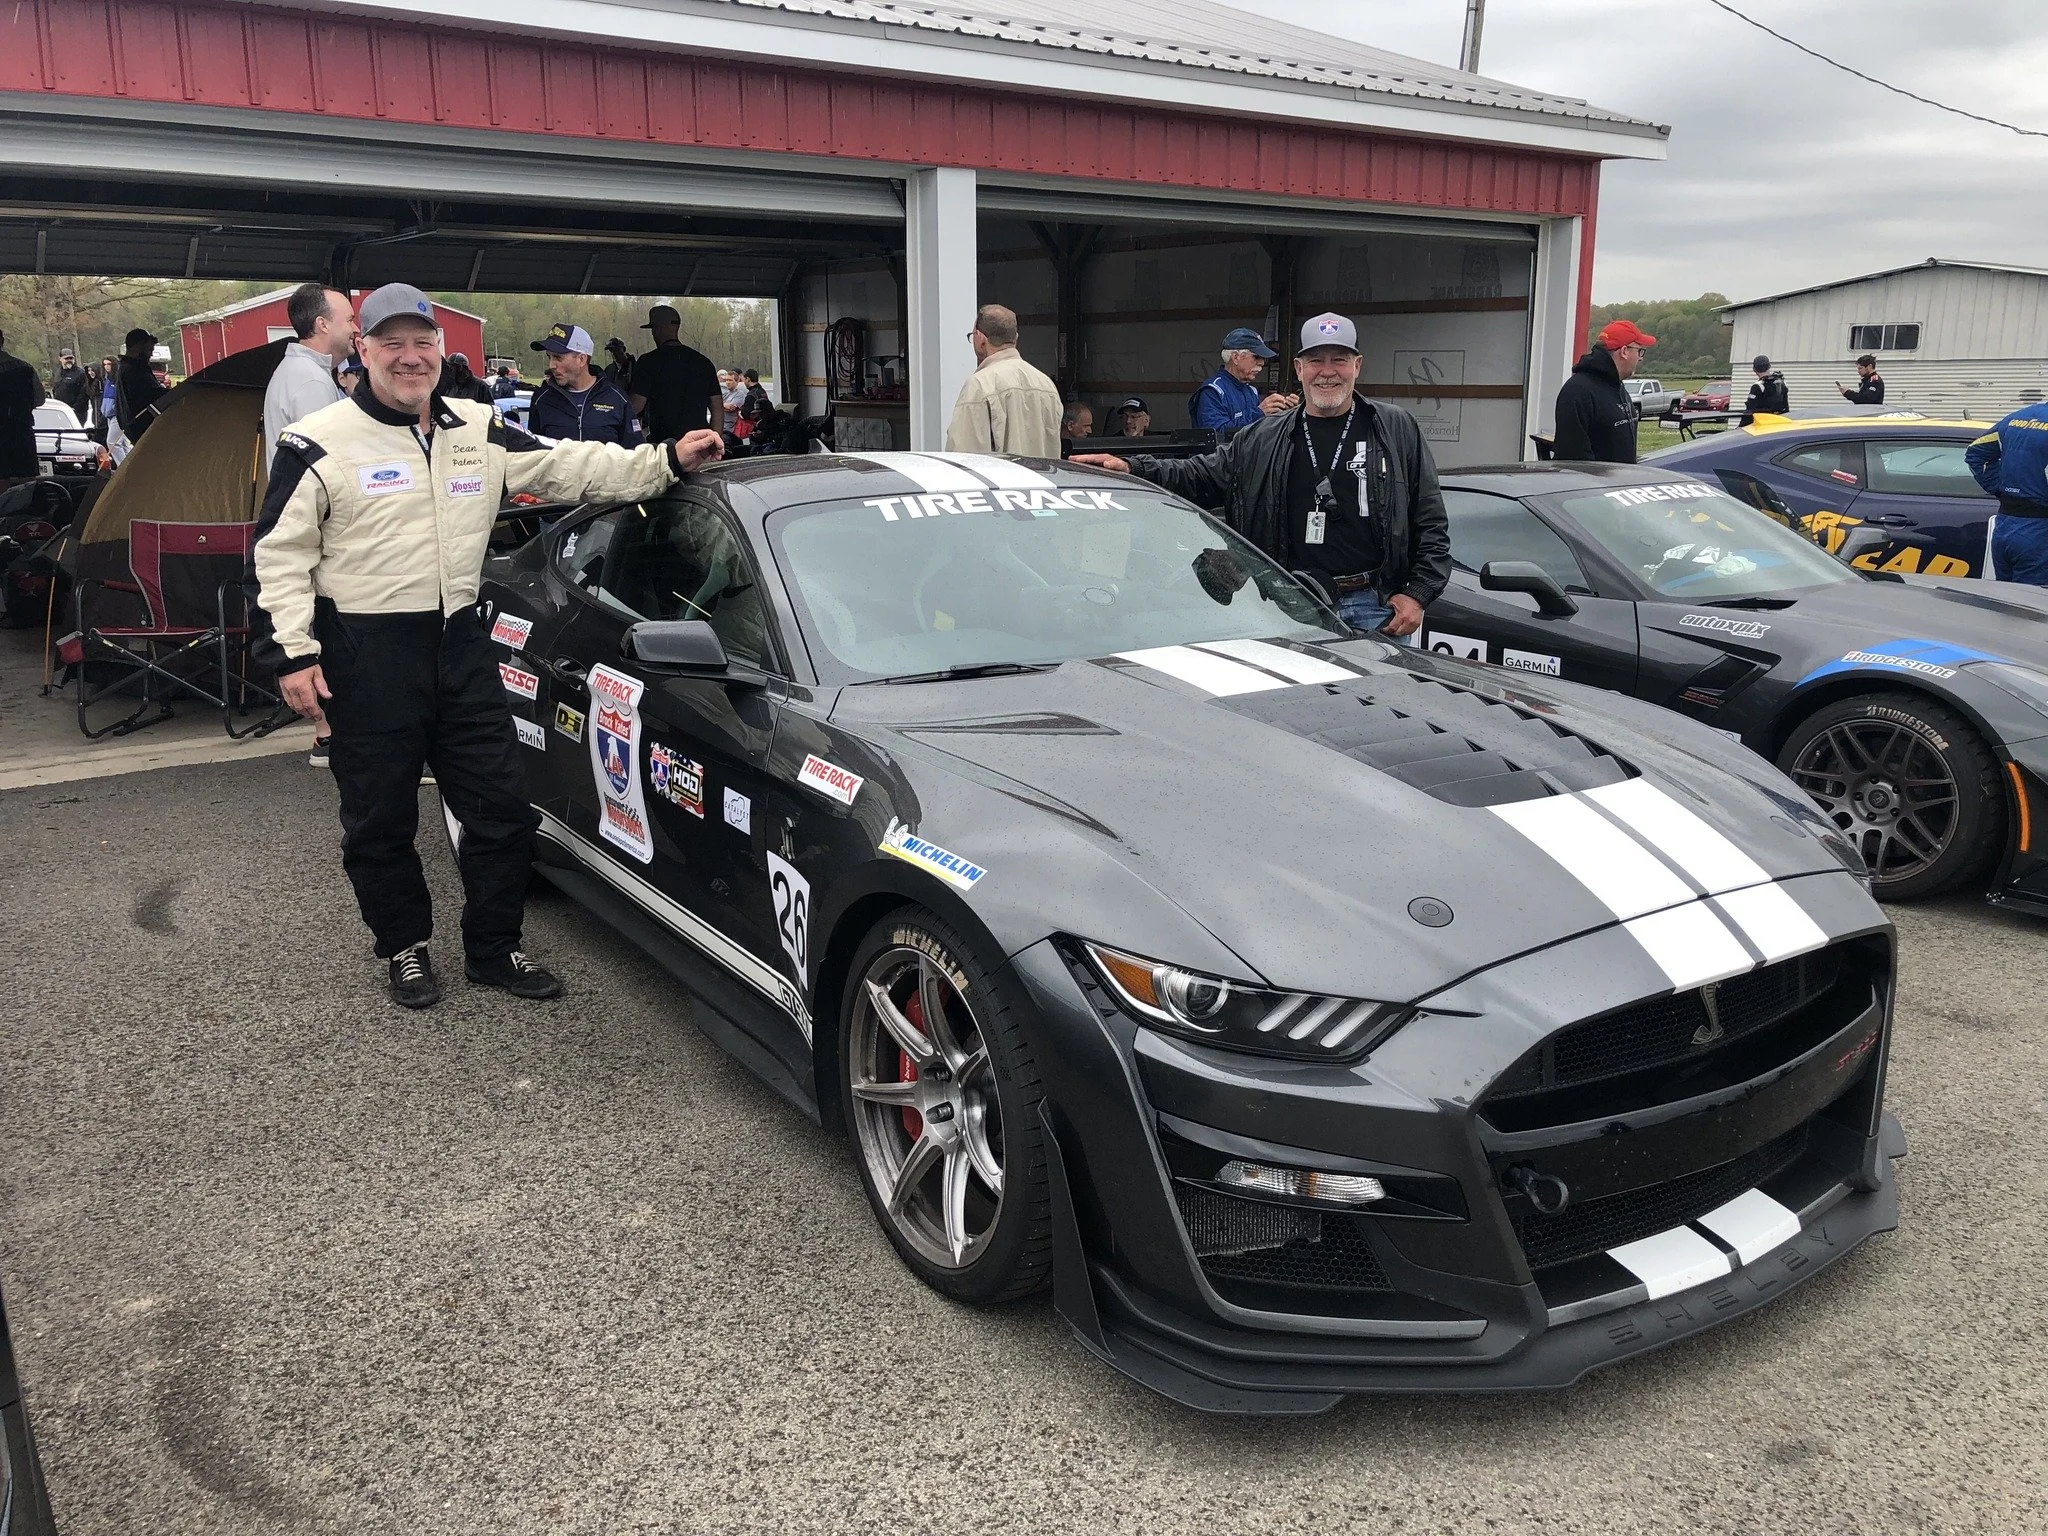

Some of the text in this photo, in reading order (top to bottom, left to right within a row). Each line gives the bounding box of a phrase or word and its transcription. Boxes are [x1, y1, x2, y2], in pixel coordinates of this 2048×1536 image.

[452, 445, 477, 453] Dean
[1308, 446, 1317, 468] AMERICA
[366, 479, 409, 489] RACING
[450, 480, 483, 493] Hoosier
[863, 490, 1130, 521] TIRE RACK
[1603, 484, 1726, 507] TIRE RACK
[1680, 615, 1771, 635] autoxpix
[1505, 657, 1556, 675] GARMIN
[1841, 651, 1957, 678] BRIDGESTONE
[593, 673, 635, 703] TIRE RACK
[599, 711, 614, 729] Brock
[519, 729, 543, 749] RMIN
[804, 757, 860, 802] TIRE RACK
[832, 788, 848, 799] .com
[724, 801, 749, 820] CATALYST
[902, 837, 984, 882] MICHELIN
[773, 870, 807, 969] 26
